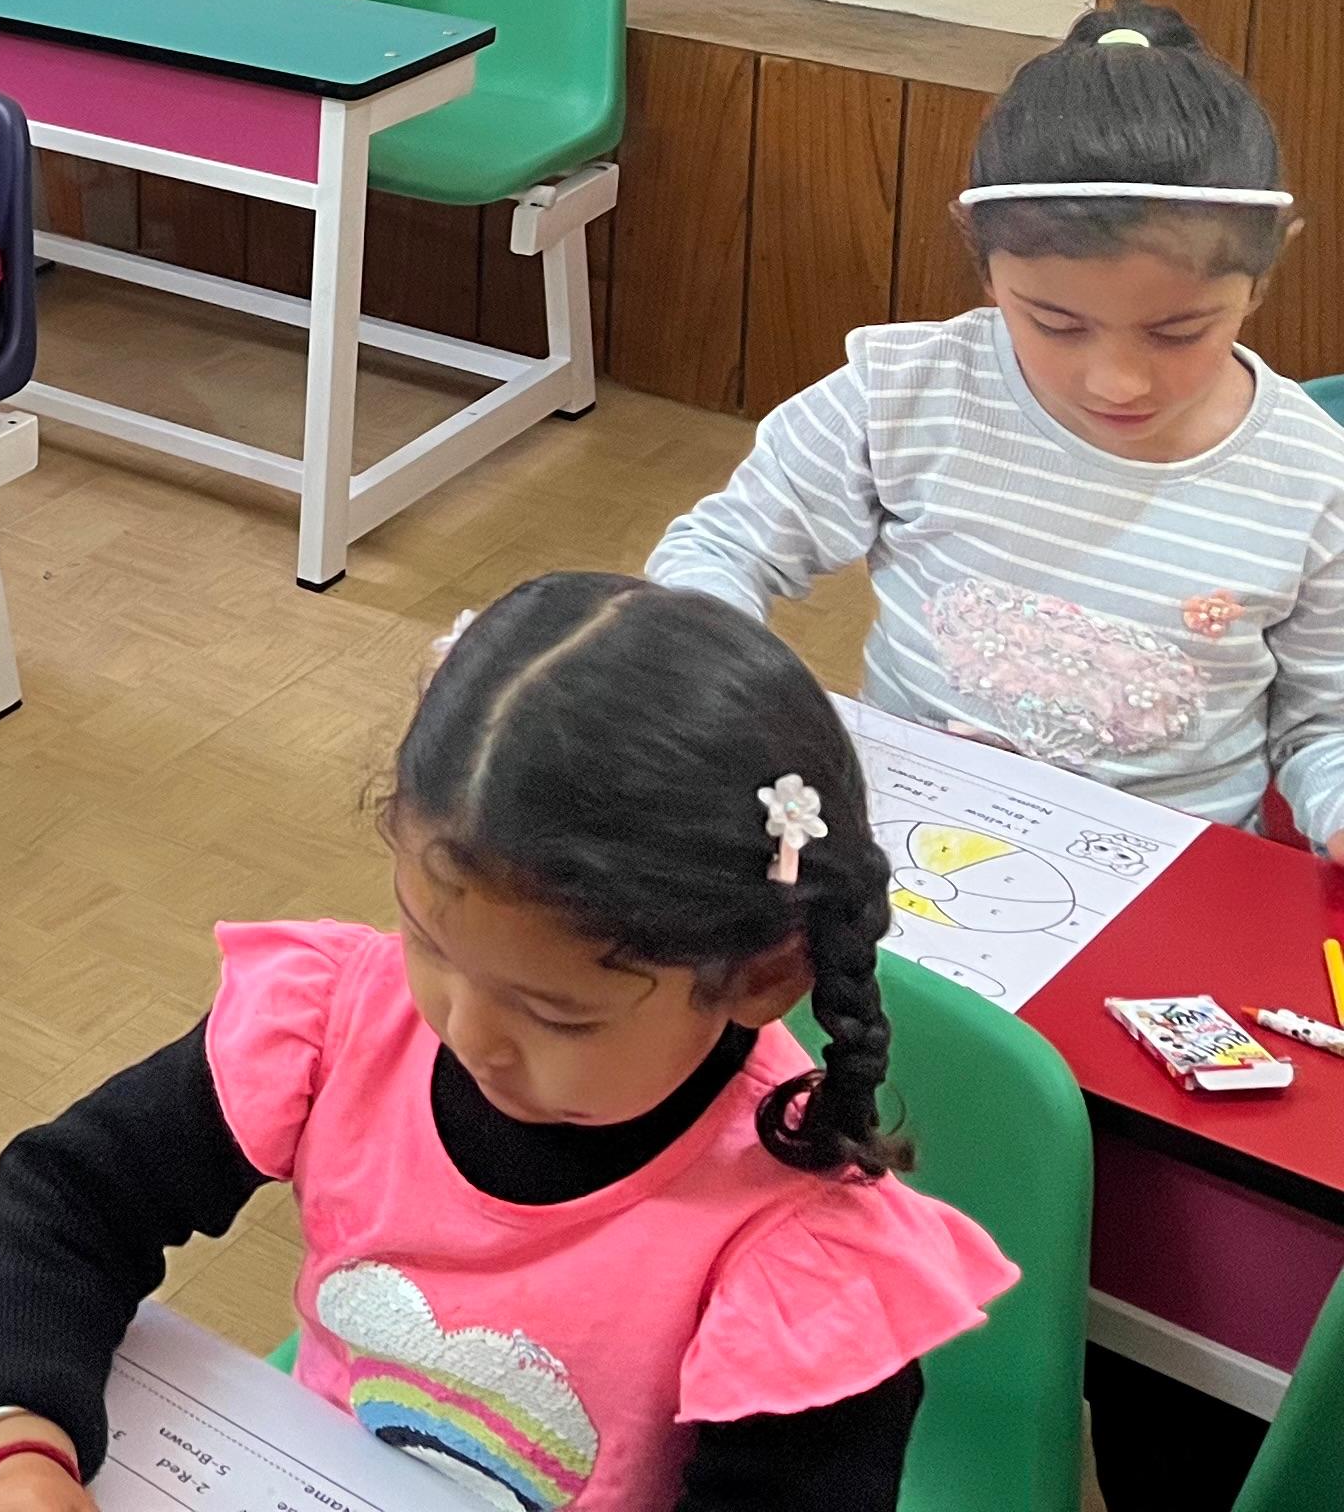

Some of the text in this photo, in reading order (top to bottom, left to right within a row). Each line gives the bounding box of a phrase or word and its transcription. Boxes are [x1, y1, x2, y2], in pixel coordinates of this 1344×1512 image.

[892, 783, 939, 802] 2-Red
[1008, 796, 1053, 816] Name
[158, 1426, 232, 1477] 5-Brown
[155, 1457, 211, 1495] 2-Red
